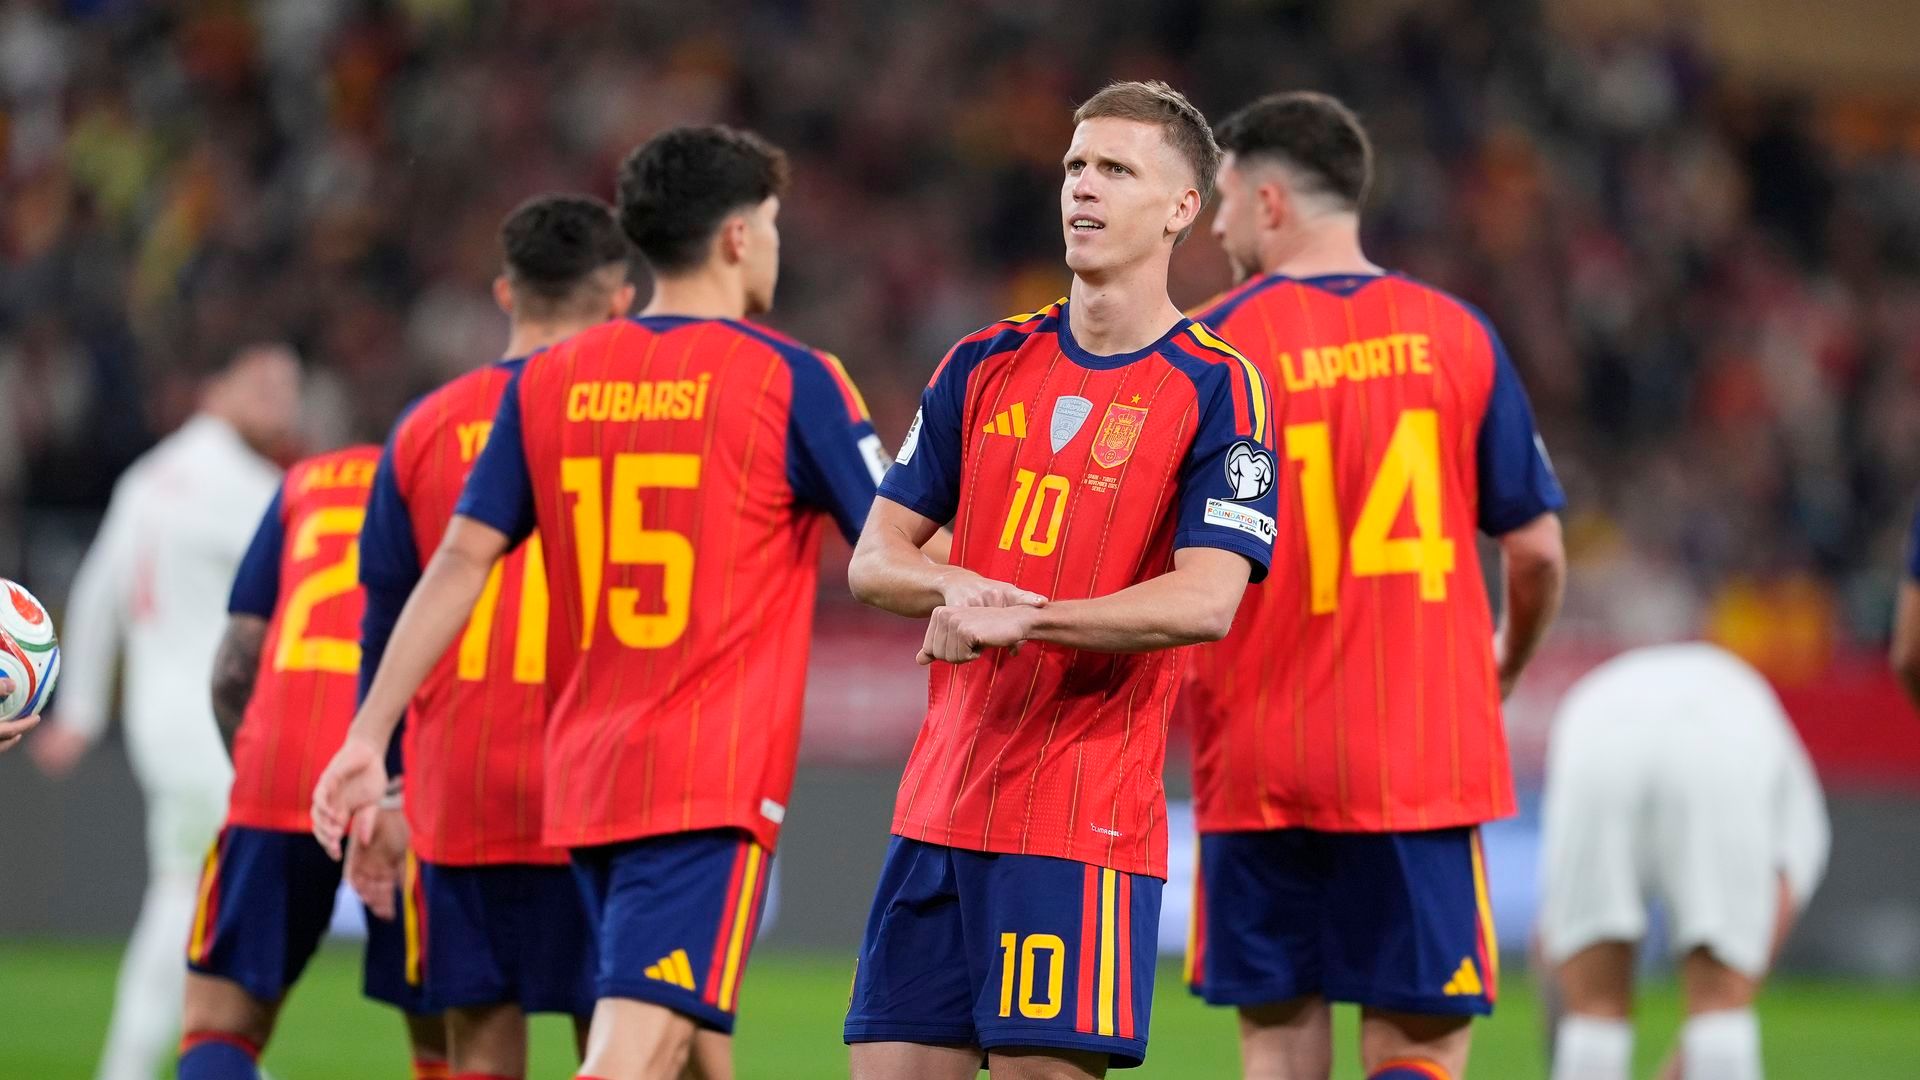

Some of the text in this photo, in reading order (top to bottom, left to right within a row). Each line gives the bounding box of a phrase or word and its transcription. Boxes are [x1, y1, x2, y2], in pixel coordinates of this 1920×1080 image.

[567, 372, 711, 422] CUBARSÍ
[1279, 333, 1433, 392] LAPORTE
[561, 453, 700, 649] 15
[998, 468, 1070, 557] 10
[1208, 507, 1258, 527] FOUNDATION
[1284, 409, 1455, 615] 14
[999, 932, 1066, 1019] 10
